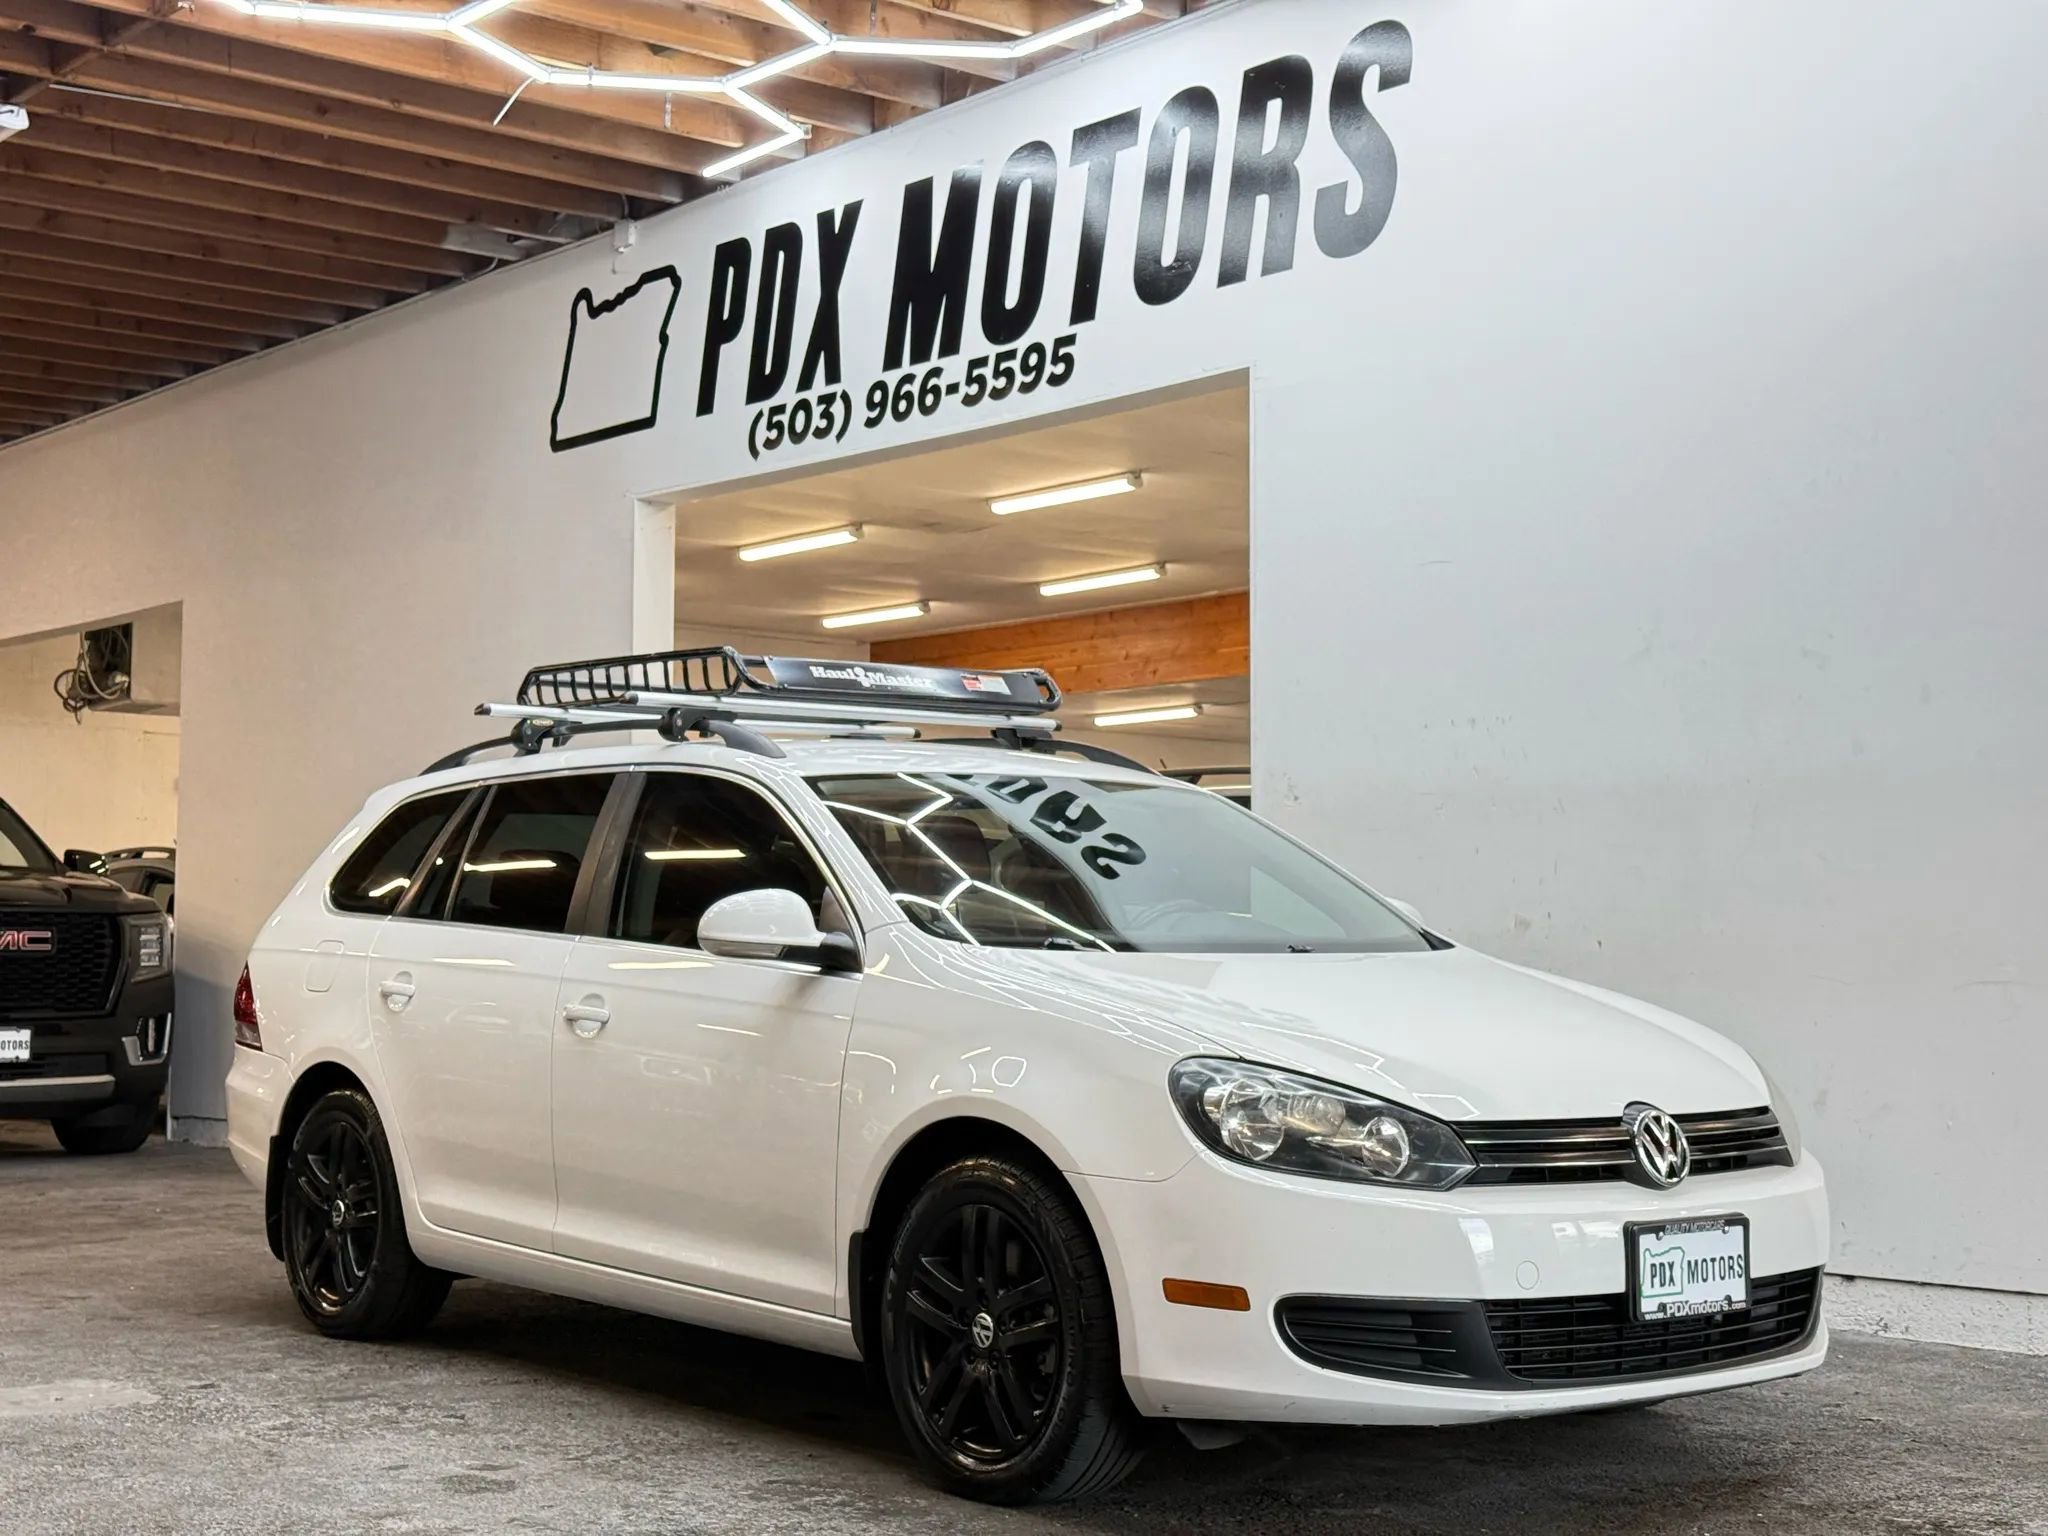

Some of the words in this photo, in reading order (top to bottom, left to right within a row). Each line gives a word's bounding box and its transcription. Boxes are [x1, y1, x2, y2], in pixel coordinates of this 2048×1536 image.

[696, 199, 865, 418] PDX
[883, 19, 1414, 373] MOTORS
[748, 388, 854, 461] (503)
[863, 333, 1077, 430] 966-5595
[809, 665, 857, 681] Haul
[866, 671, 935, 688] Master
[0, 1039, 30, 1051] OTORS
[1650, 1261, 1676, 1289] PDX
[1687, 1254, 1744, 1285] MOTORS
[1644, 1300, 1747, 1320] www.PDXmotors.com
